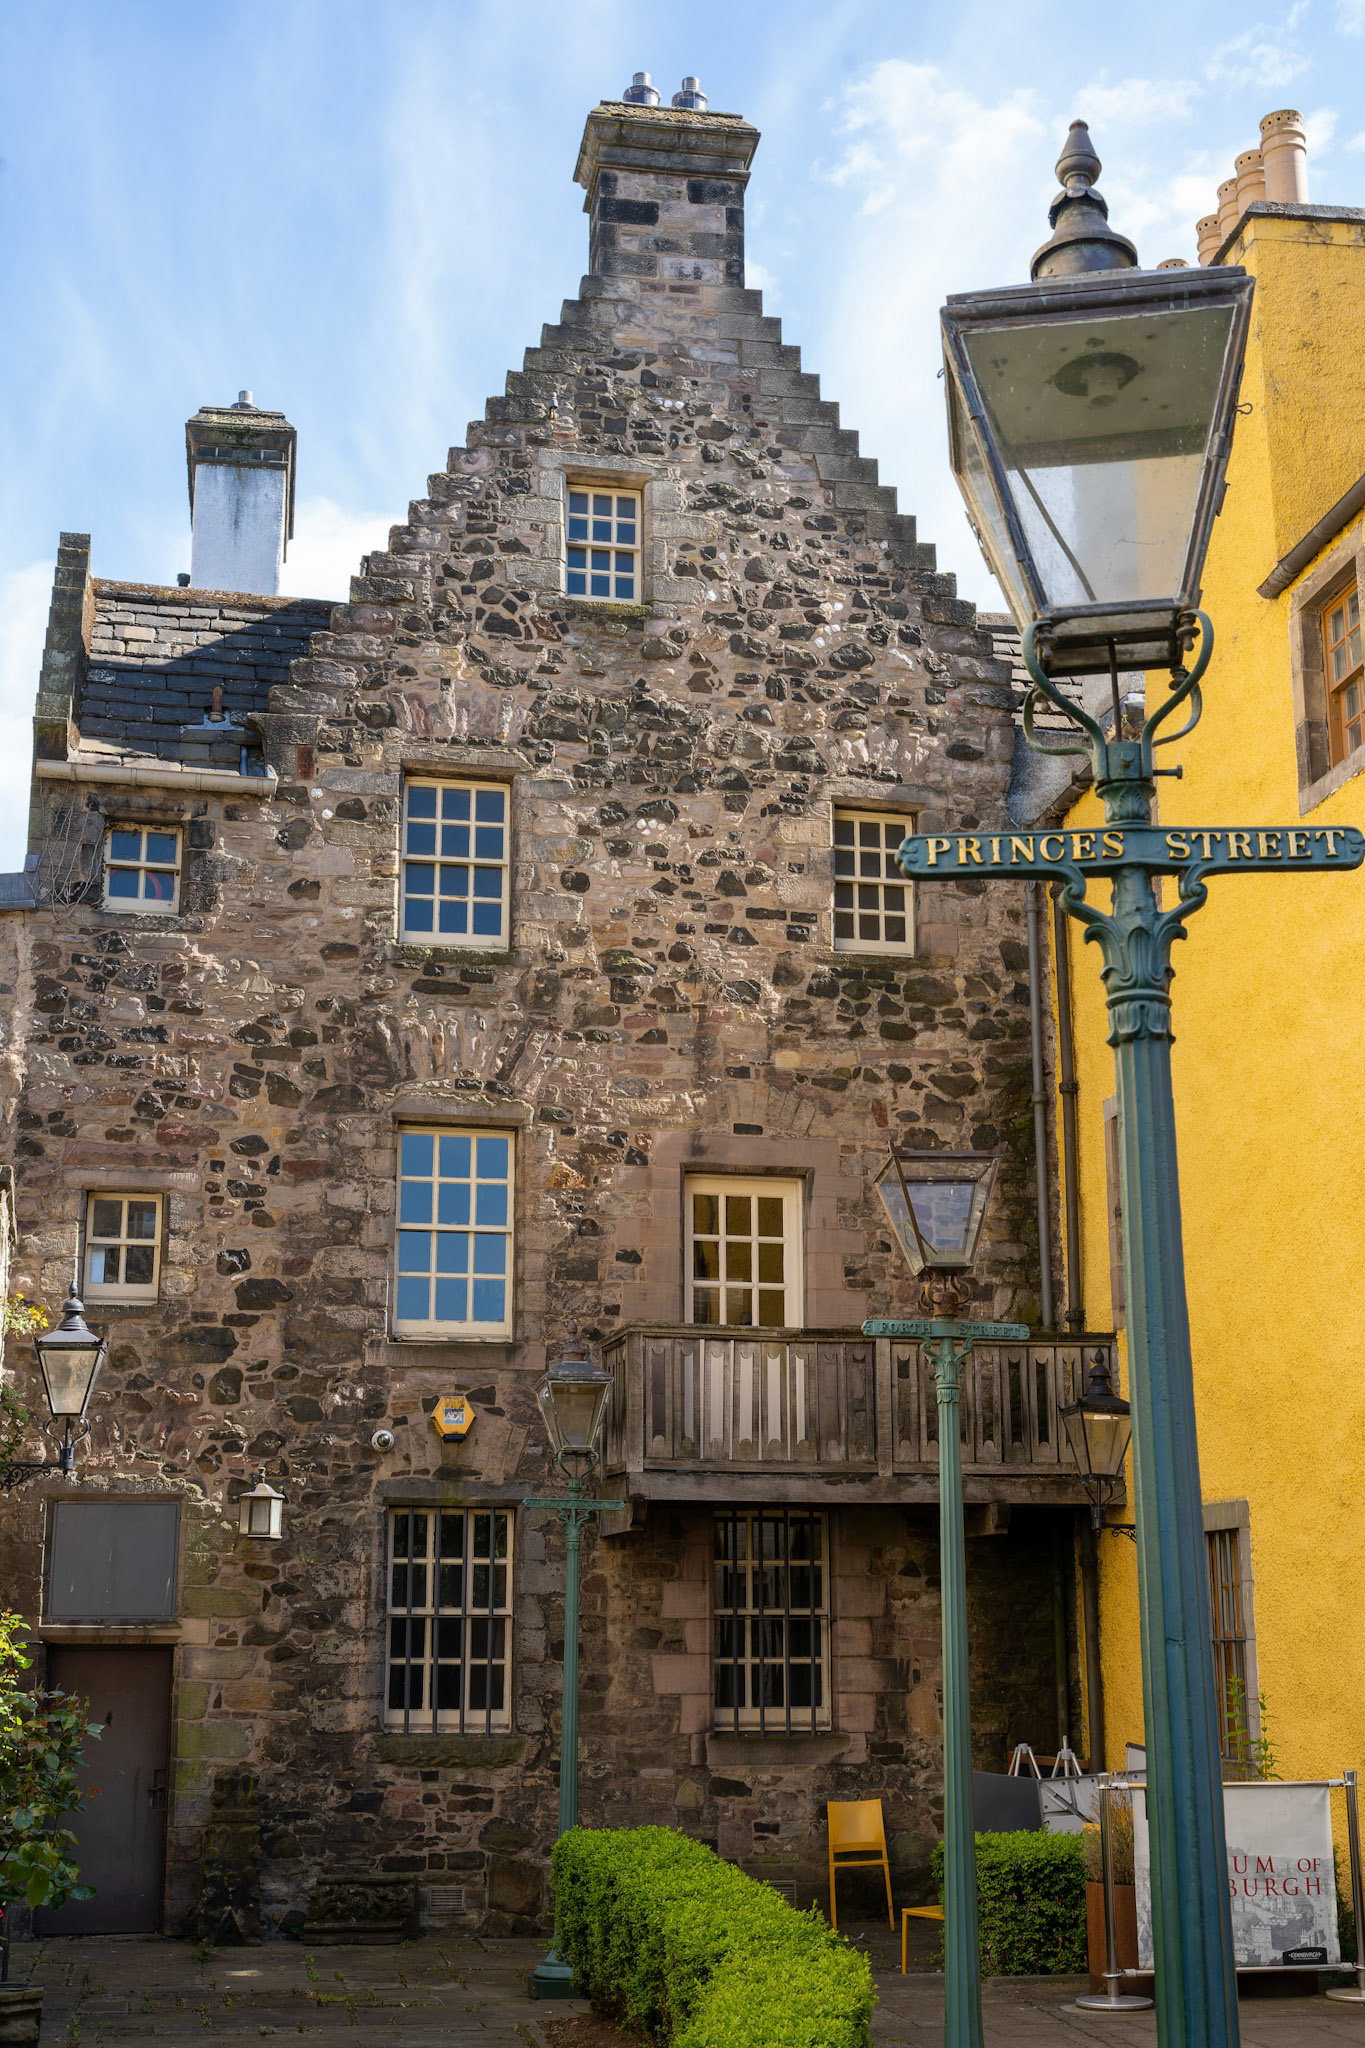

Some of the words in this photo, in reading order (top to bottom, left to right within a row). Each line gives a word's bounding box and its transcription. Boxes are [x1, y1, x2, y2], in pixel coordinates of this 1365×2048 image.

[926, 831, 1125, 866] PRINCES
[1165, 829, 1346, 861] STREET
[879, 1321, 933, 1335] FORTH
[959, 1323, 1021, 1339] STREET
[444, 1411, 465, 1421] ADT
[1297, 1857, 1321, 1873] OF
[1228, 1876, 1321, 1897] BURGH
